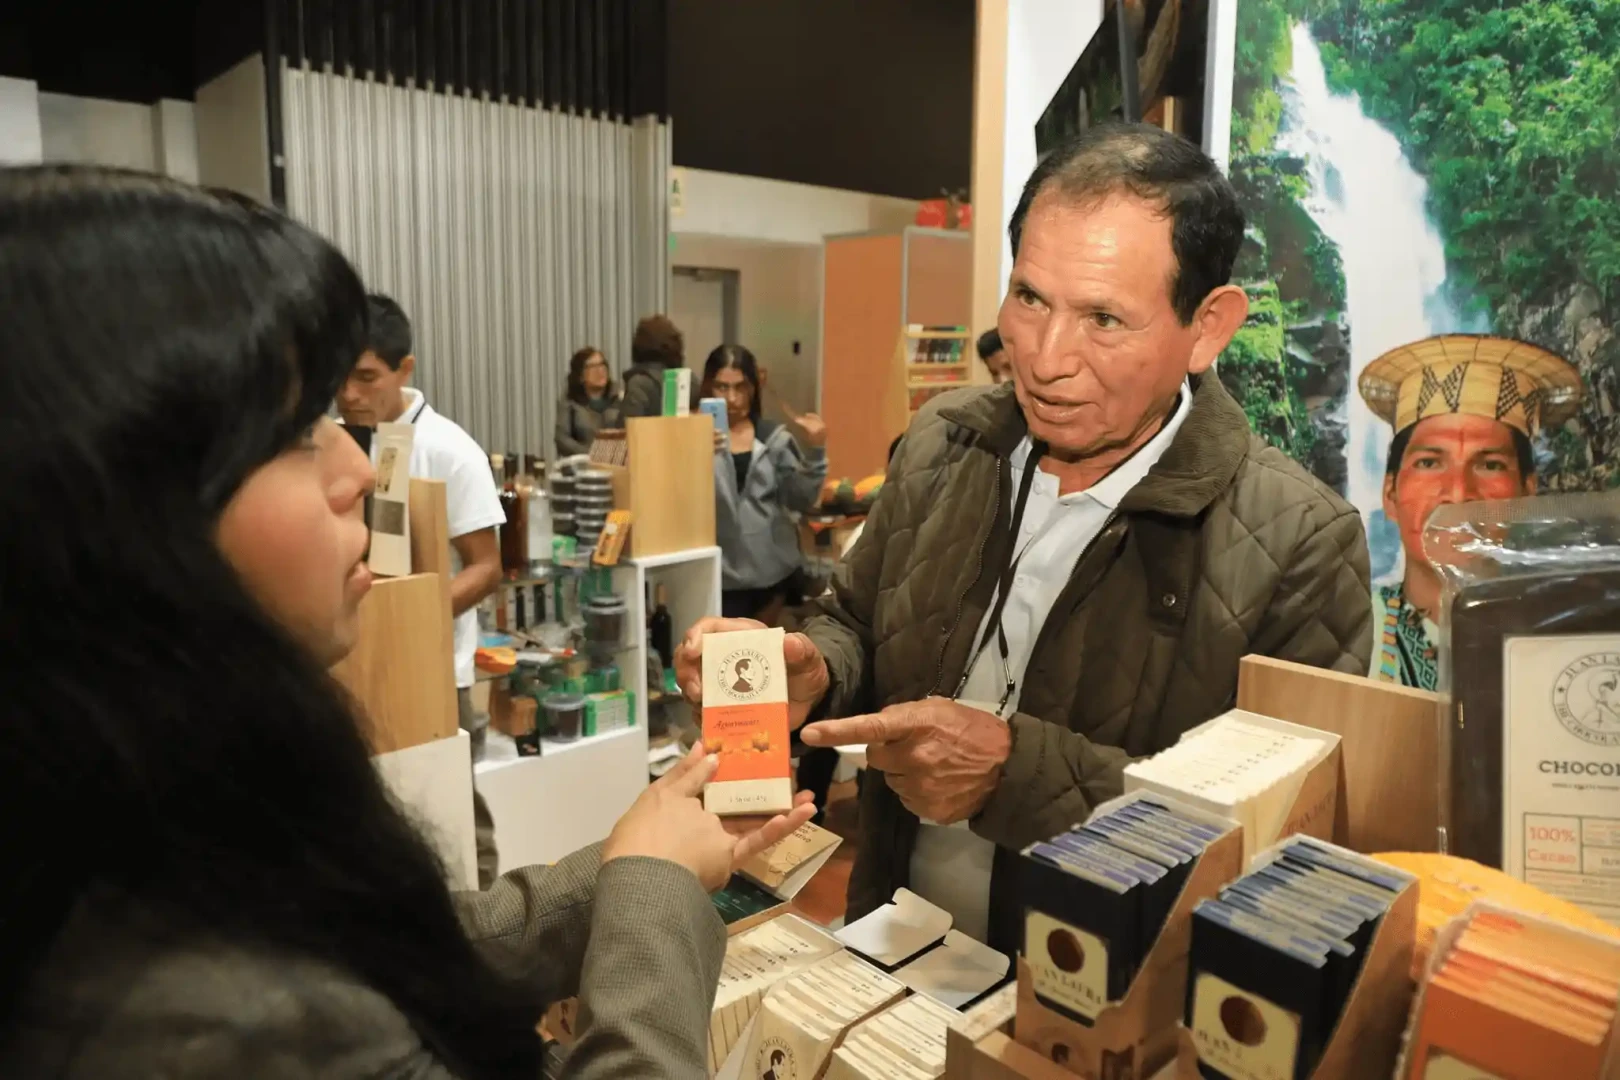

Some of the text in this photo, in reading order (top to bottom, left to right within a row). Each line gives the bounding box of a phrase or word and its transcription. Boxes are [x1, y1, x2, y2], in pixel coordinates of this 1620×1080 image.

[1564, 655, 1598, 680] JUAN
[1528, 825, 1576, 843] 100%
[1527, 847, 1576, 865] Cacao
